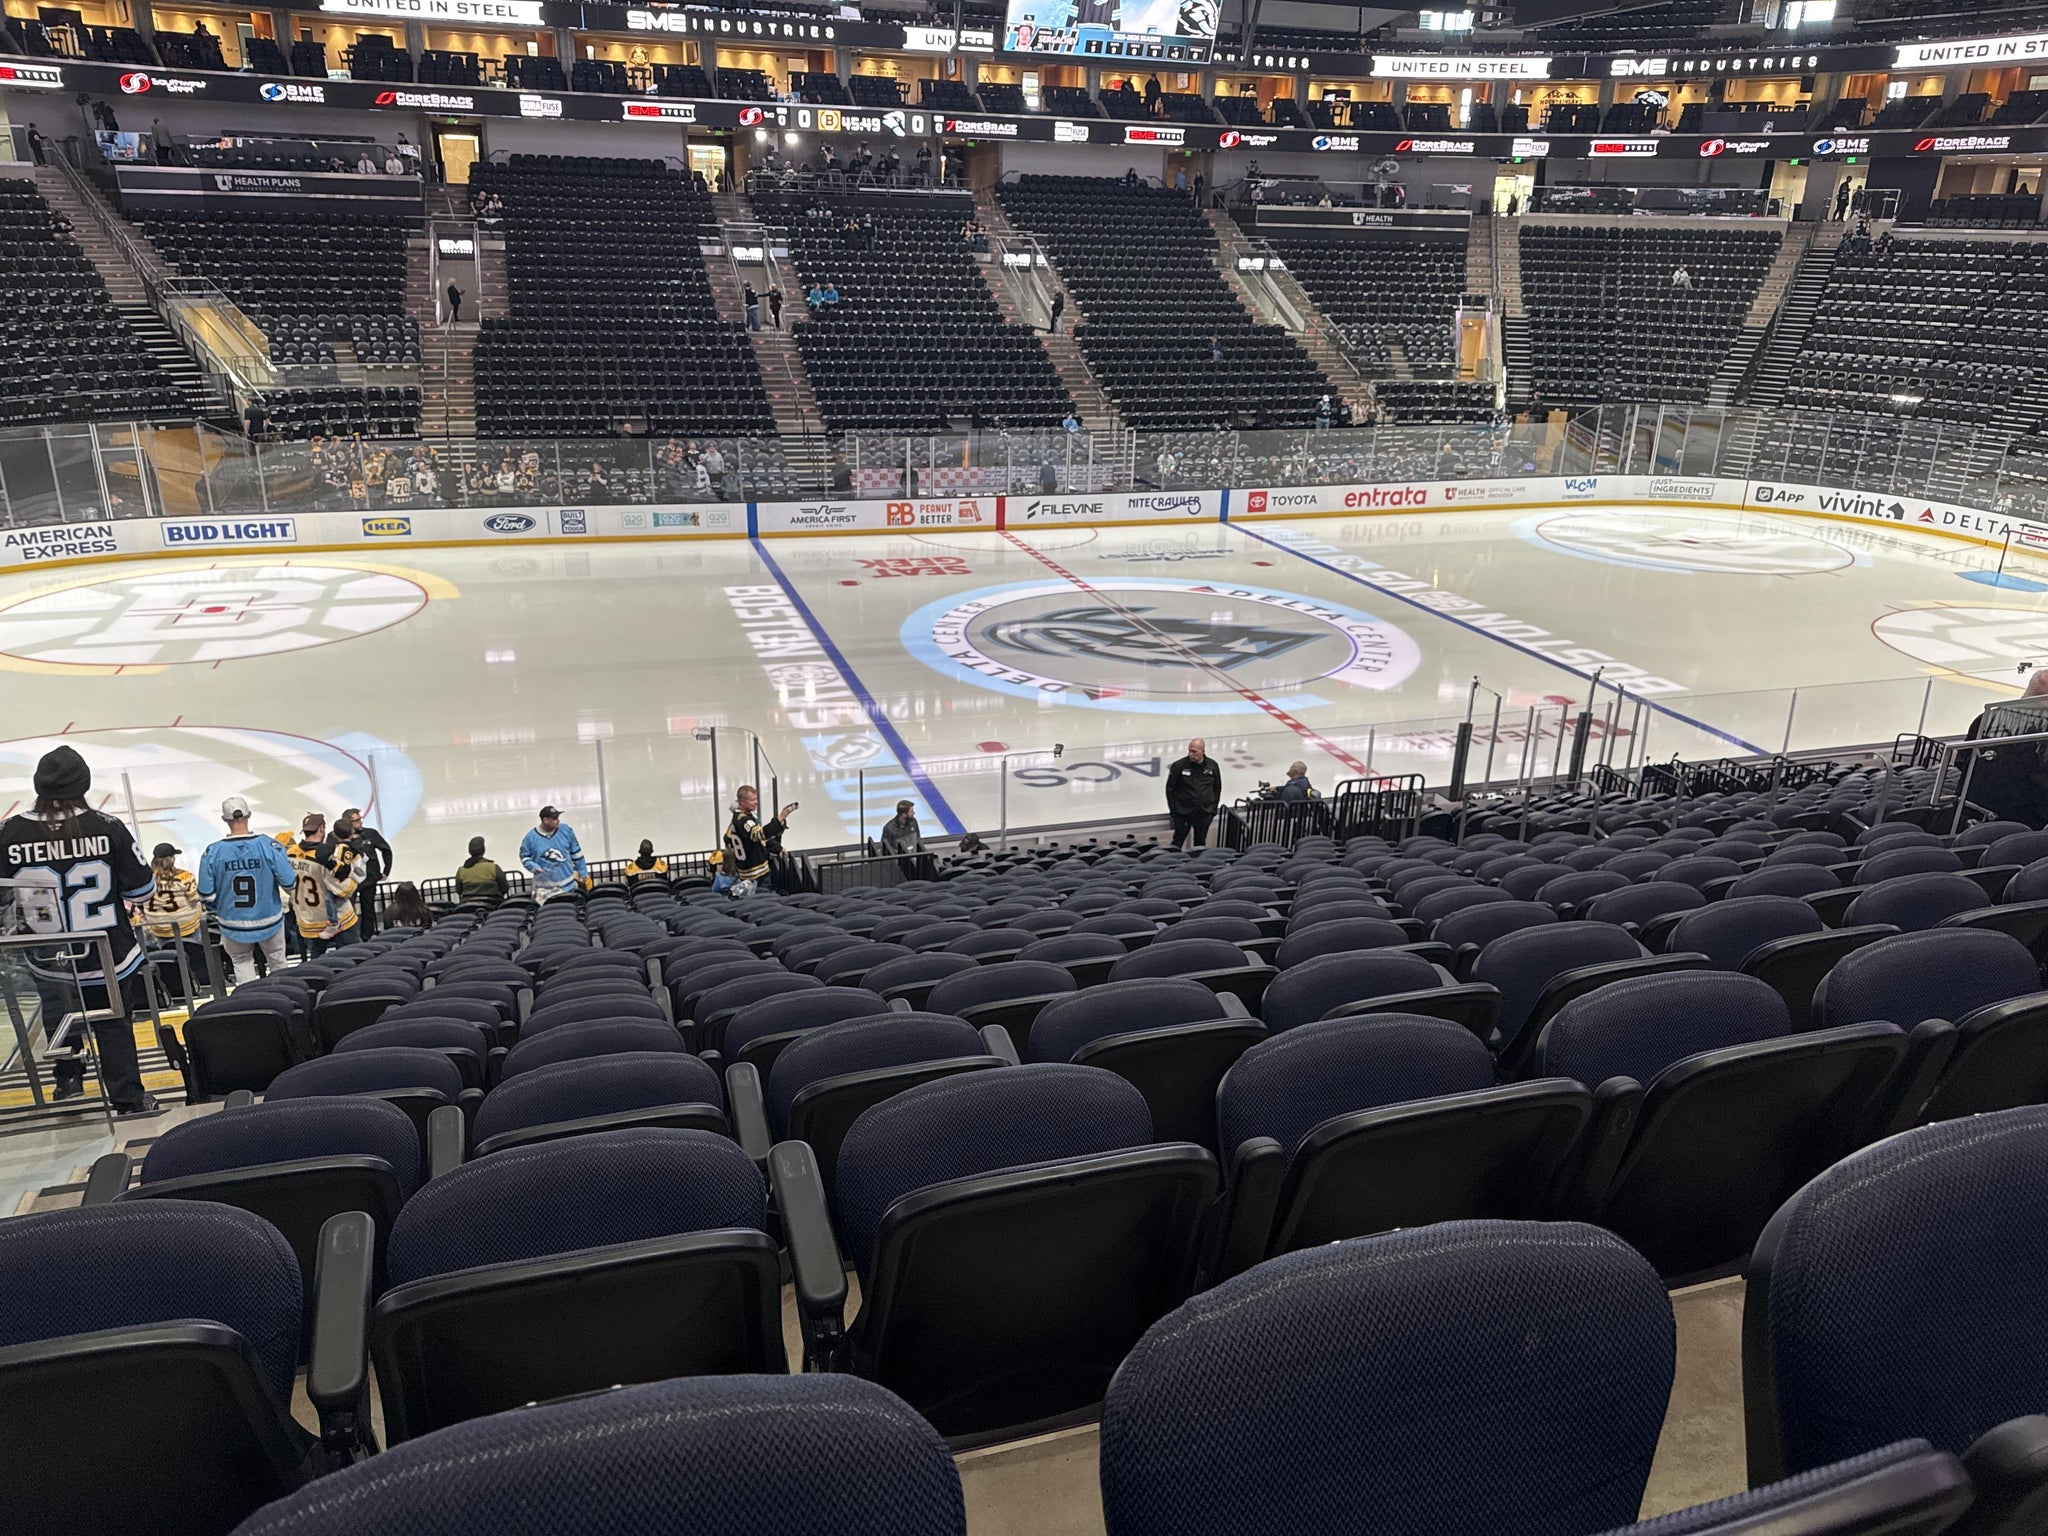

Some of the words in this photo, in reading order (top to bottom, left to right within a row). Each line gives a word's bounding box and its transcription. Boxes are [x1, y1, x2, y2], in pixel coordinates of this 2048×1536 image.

[347, 0, 421, 11] UNITED
[430, 1, 448, 13] IN
[457, 3, 519, 17] STEEL
[627, 10, 687, 32] SME
[692, 17, 835, 39] INDUSTRIES
[1919, 44, 1990, 61] UNITED
[1997, 42, 2017, 55] IN
[1391, 61, 1449, 73] UNITED
[1455, 61, 1471, 73] IN
[1478, 62, 1529, 74] STEEL
[1610, 58, 1667, 76] SME
[1672, 55, 1819, 72] INDUSTRIES
[287, 85, 324, 98] SME
[629, 106, 660, 116] SME
[798, 110, 811, 128] 0
[842, 117, 881, 132] 45:49
[912, 115, 924, 133] 0
[1331, 137, 1359, 146] SME
[1837, 138, 1870, 148] SME
[234, 177, 270, 186] HEALTH
[271, 178, 301, 188] PLANS
[1365, 214, 1393, 222] HEALTH
[1458, 488, 1485, 496] HEALTH
[1653, 485, 1710, 494] INGREDIENTS
[1271, 495, 1317, 506] TOYOTA
[1344, 486, 1427, 508] entrata
[886, 503, 915, 526] PB
[919, 504, 953, 513] PEANUT
[1041, 503, 1103, 515] FILEVINE
[562, 512, 583, 520] BUILT
[624, 514, 643, 523] G2G
[662, 514, 681, 522] G2G
[709, 512, 727, 521] G2G
[790, 516, 829, 524] AMERICA
[831, 515, 857, 523] FIRST
[920, 515, 953, 524] BETTER
[1943, 511, 2010, 535] DELTA
[367, 522, 408, 532] IKEA
[493, 516, 527, 531] Ford
[5, 525, 112, 547] AMERICAN
[167, 525, 219, 541] BUD
[223, 522, 290, 539] LIGHT
[23, 539, 117, 560] EXPRESS
[854, 556, 965, 569] GEEK
[872, 565, 972, 578] SEAT
[723, 585, 825, 658] BOSTON
[932, 602, 993, 644] CENTER
[1229, 590, 1345, 621] DELTA
[1347, 625, 1392, 673] CENTER
[1465, 612, 1689, 696] BOSTON
[949, 651, 1070, 692] DELTA
[1013, 757, 1172, 787] ACS
[8, 836, 110, 864] STENLUND
[224, 858, 261, 872] KELLER
[232, 875, 257, 908] 9
